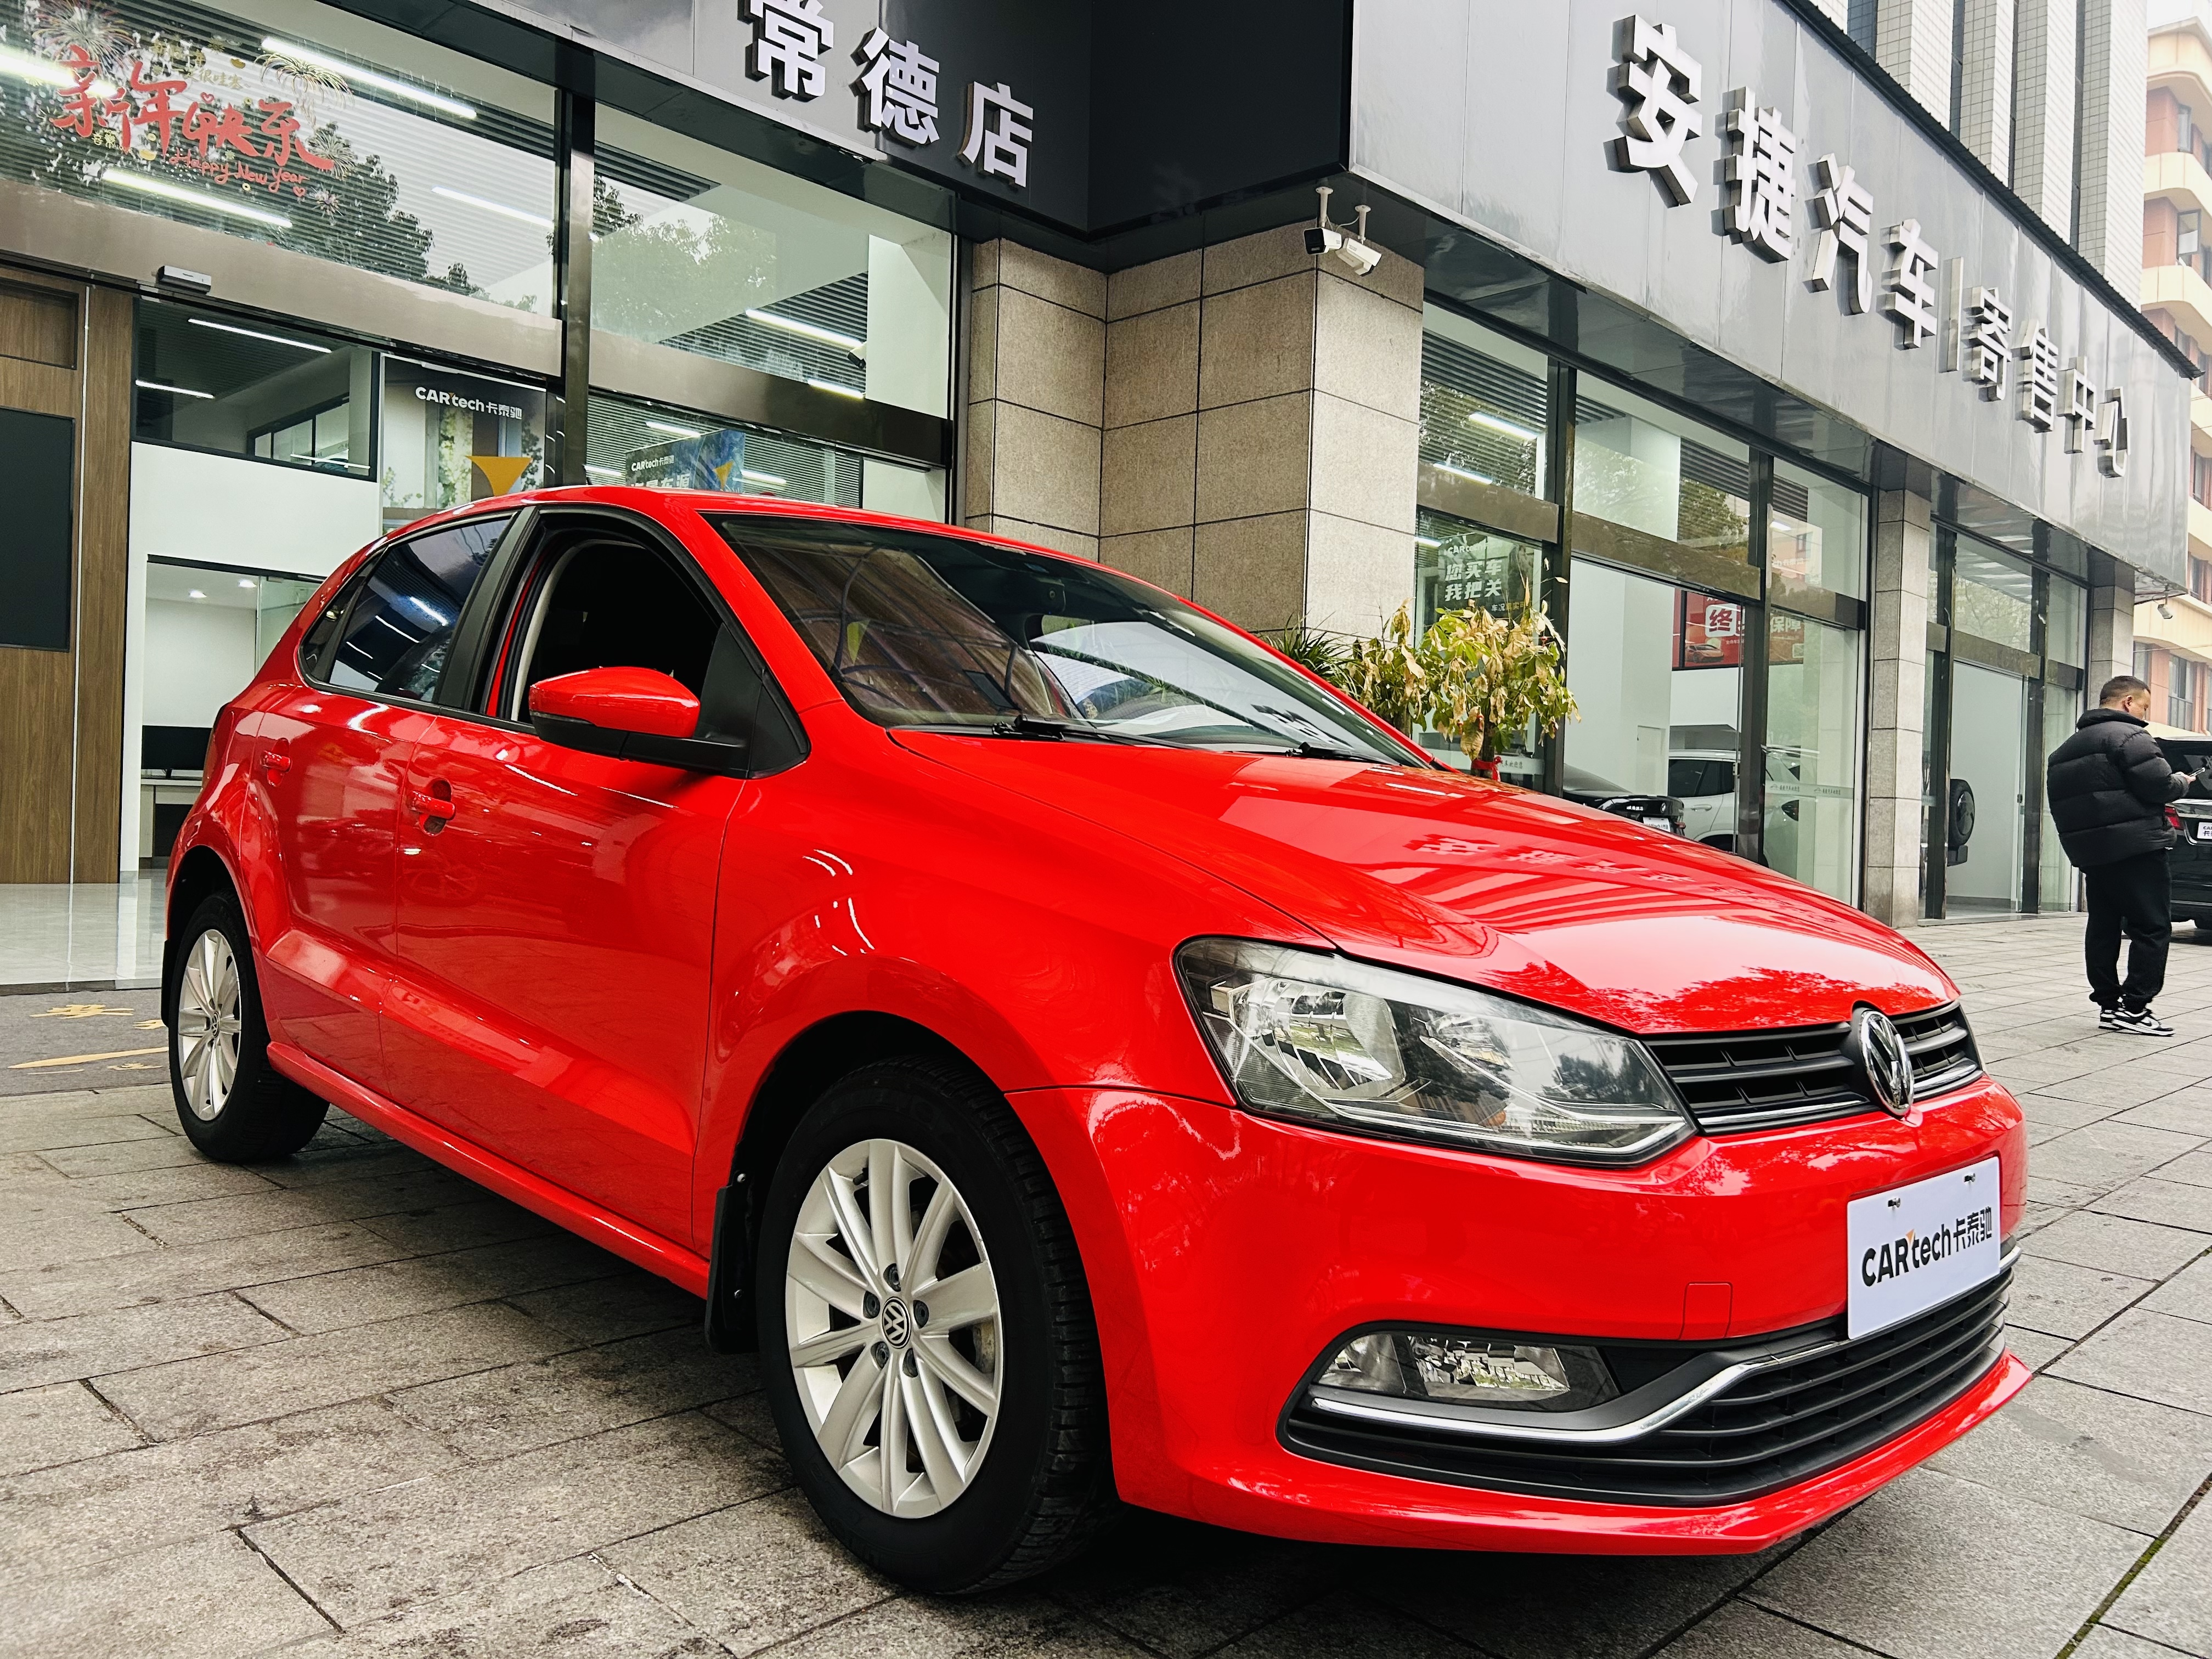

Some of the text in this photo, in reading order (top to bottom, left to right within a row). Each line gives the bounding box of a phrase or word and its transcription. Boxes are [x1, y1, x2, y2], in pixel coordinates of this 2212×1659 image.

[50, 44, 334, 170] 新年快乐
[747, 0, 1034, 188] 常德店
[169, 147, 229, 184] Happy
[233, 161, 268, 185] New
[415, 387, 484, 412] CARtech
[1445, 559, 1502, 582] 您买车
[1444, 578, 1502, 602] 我把关
[1861, 1206, 1993, 1287] CARtech 卡泰驰
